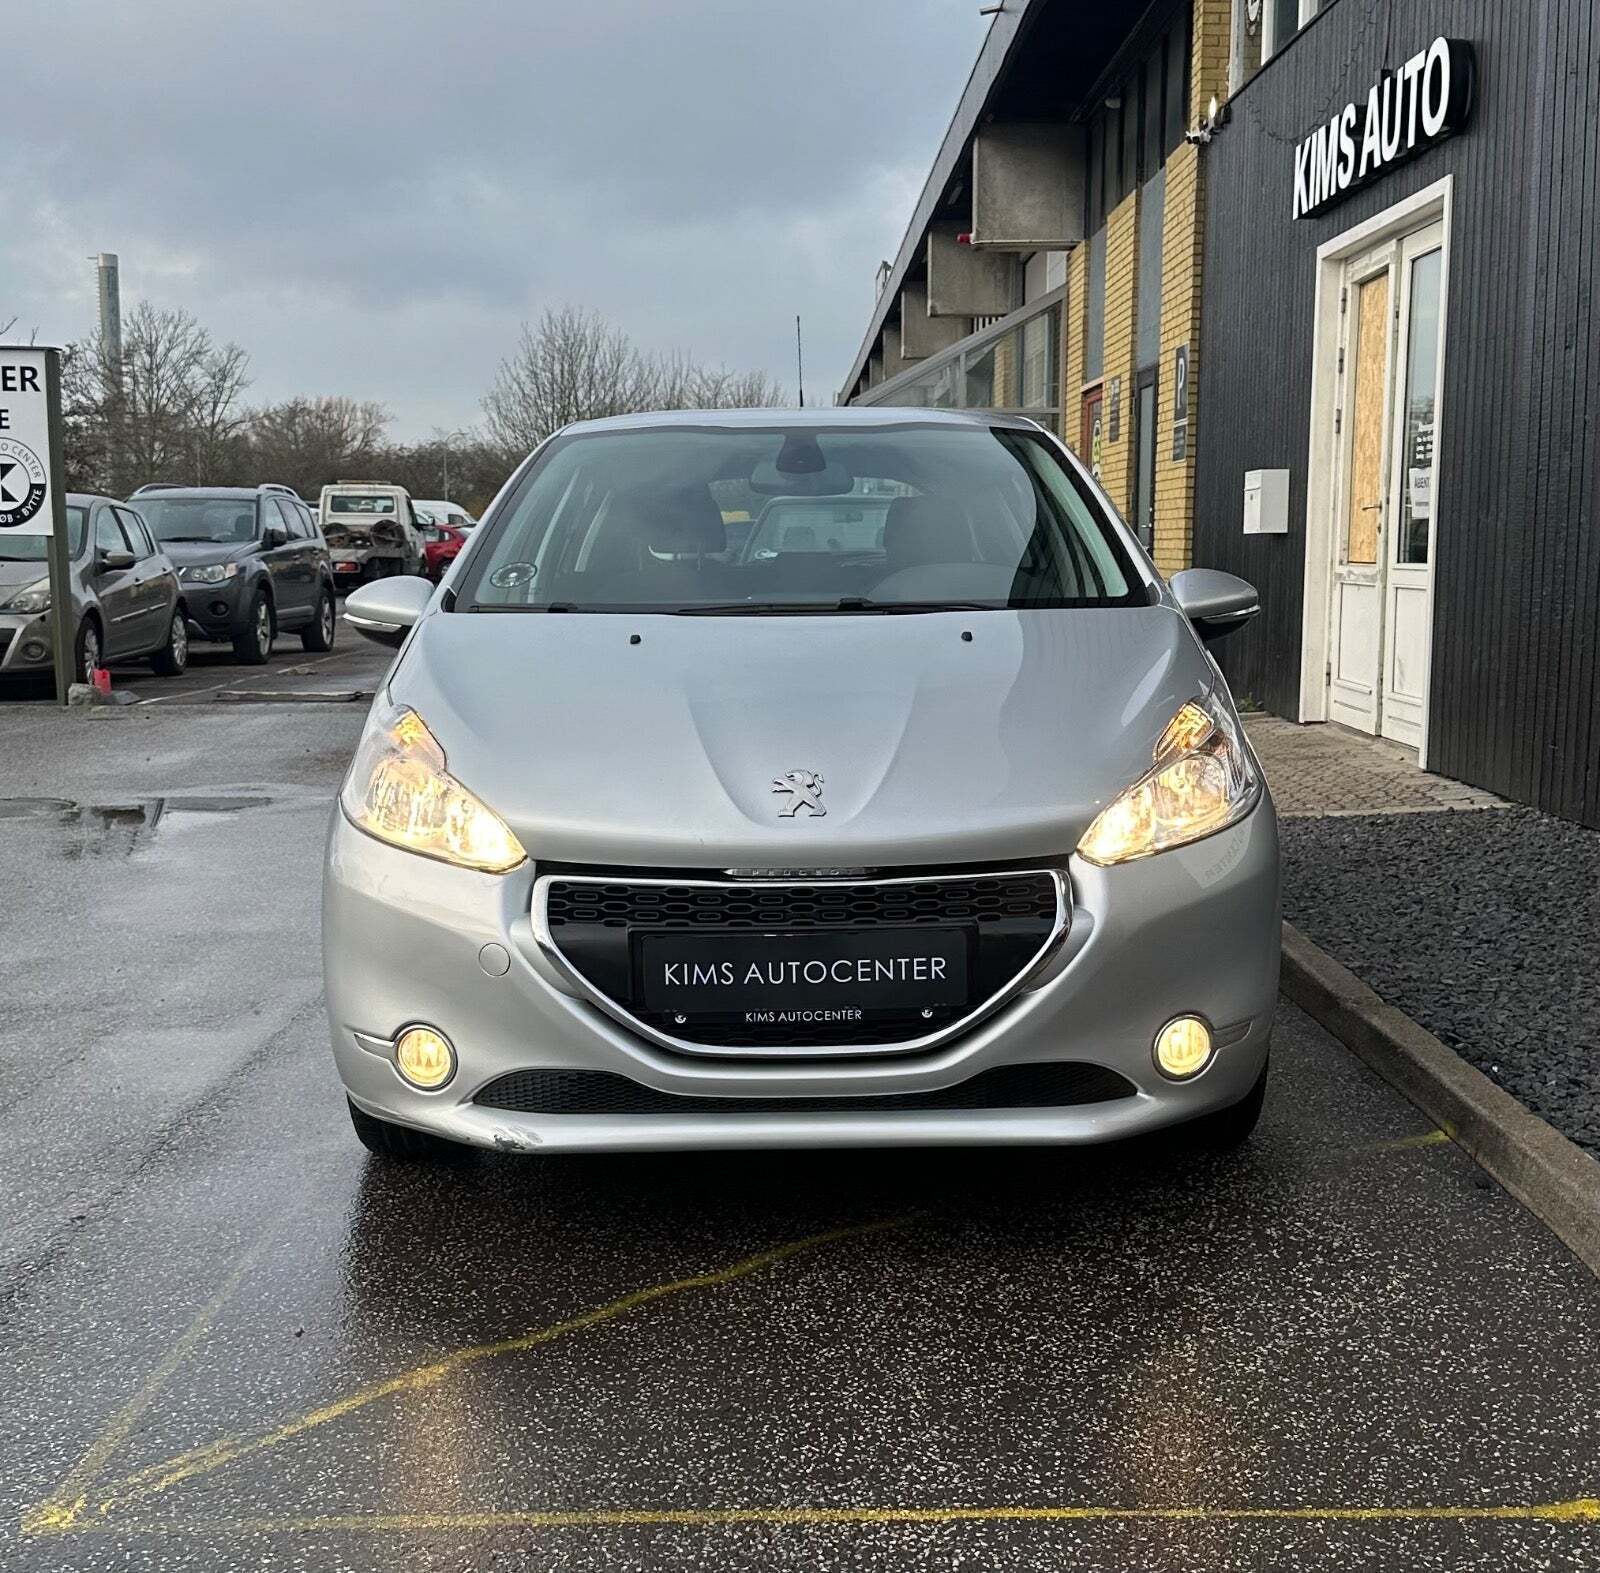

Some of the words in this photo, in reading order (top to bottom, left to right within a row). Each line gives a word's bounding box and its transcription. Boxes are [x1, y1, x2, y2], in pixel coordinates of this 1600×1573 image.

[1293, 103, 1357, 221] KIMS
[1359, 36, 1450, 178] AUTO
[12, 446, 42, 479] CENTER
[21, 488, 43, 517] BYTTE
[664, 961, 735, 986] KIMS
[743, 956, 947, 985] AUTOCENTER
[745, 1011, 776, 1024] KIMS
[777, 1009, 863, 1023] AUTOCENTER
